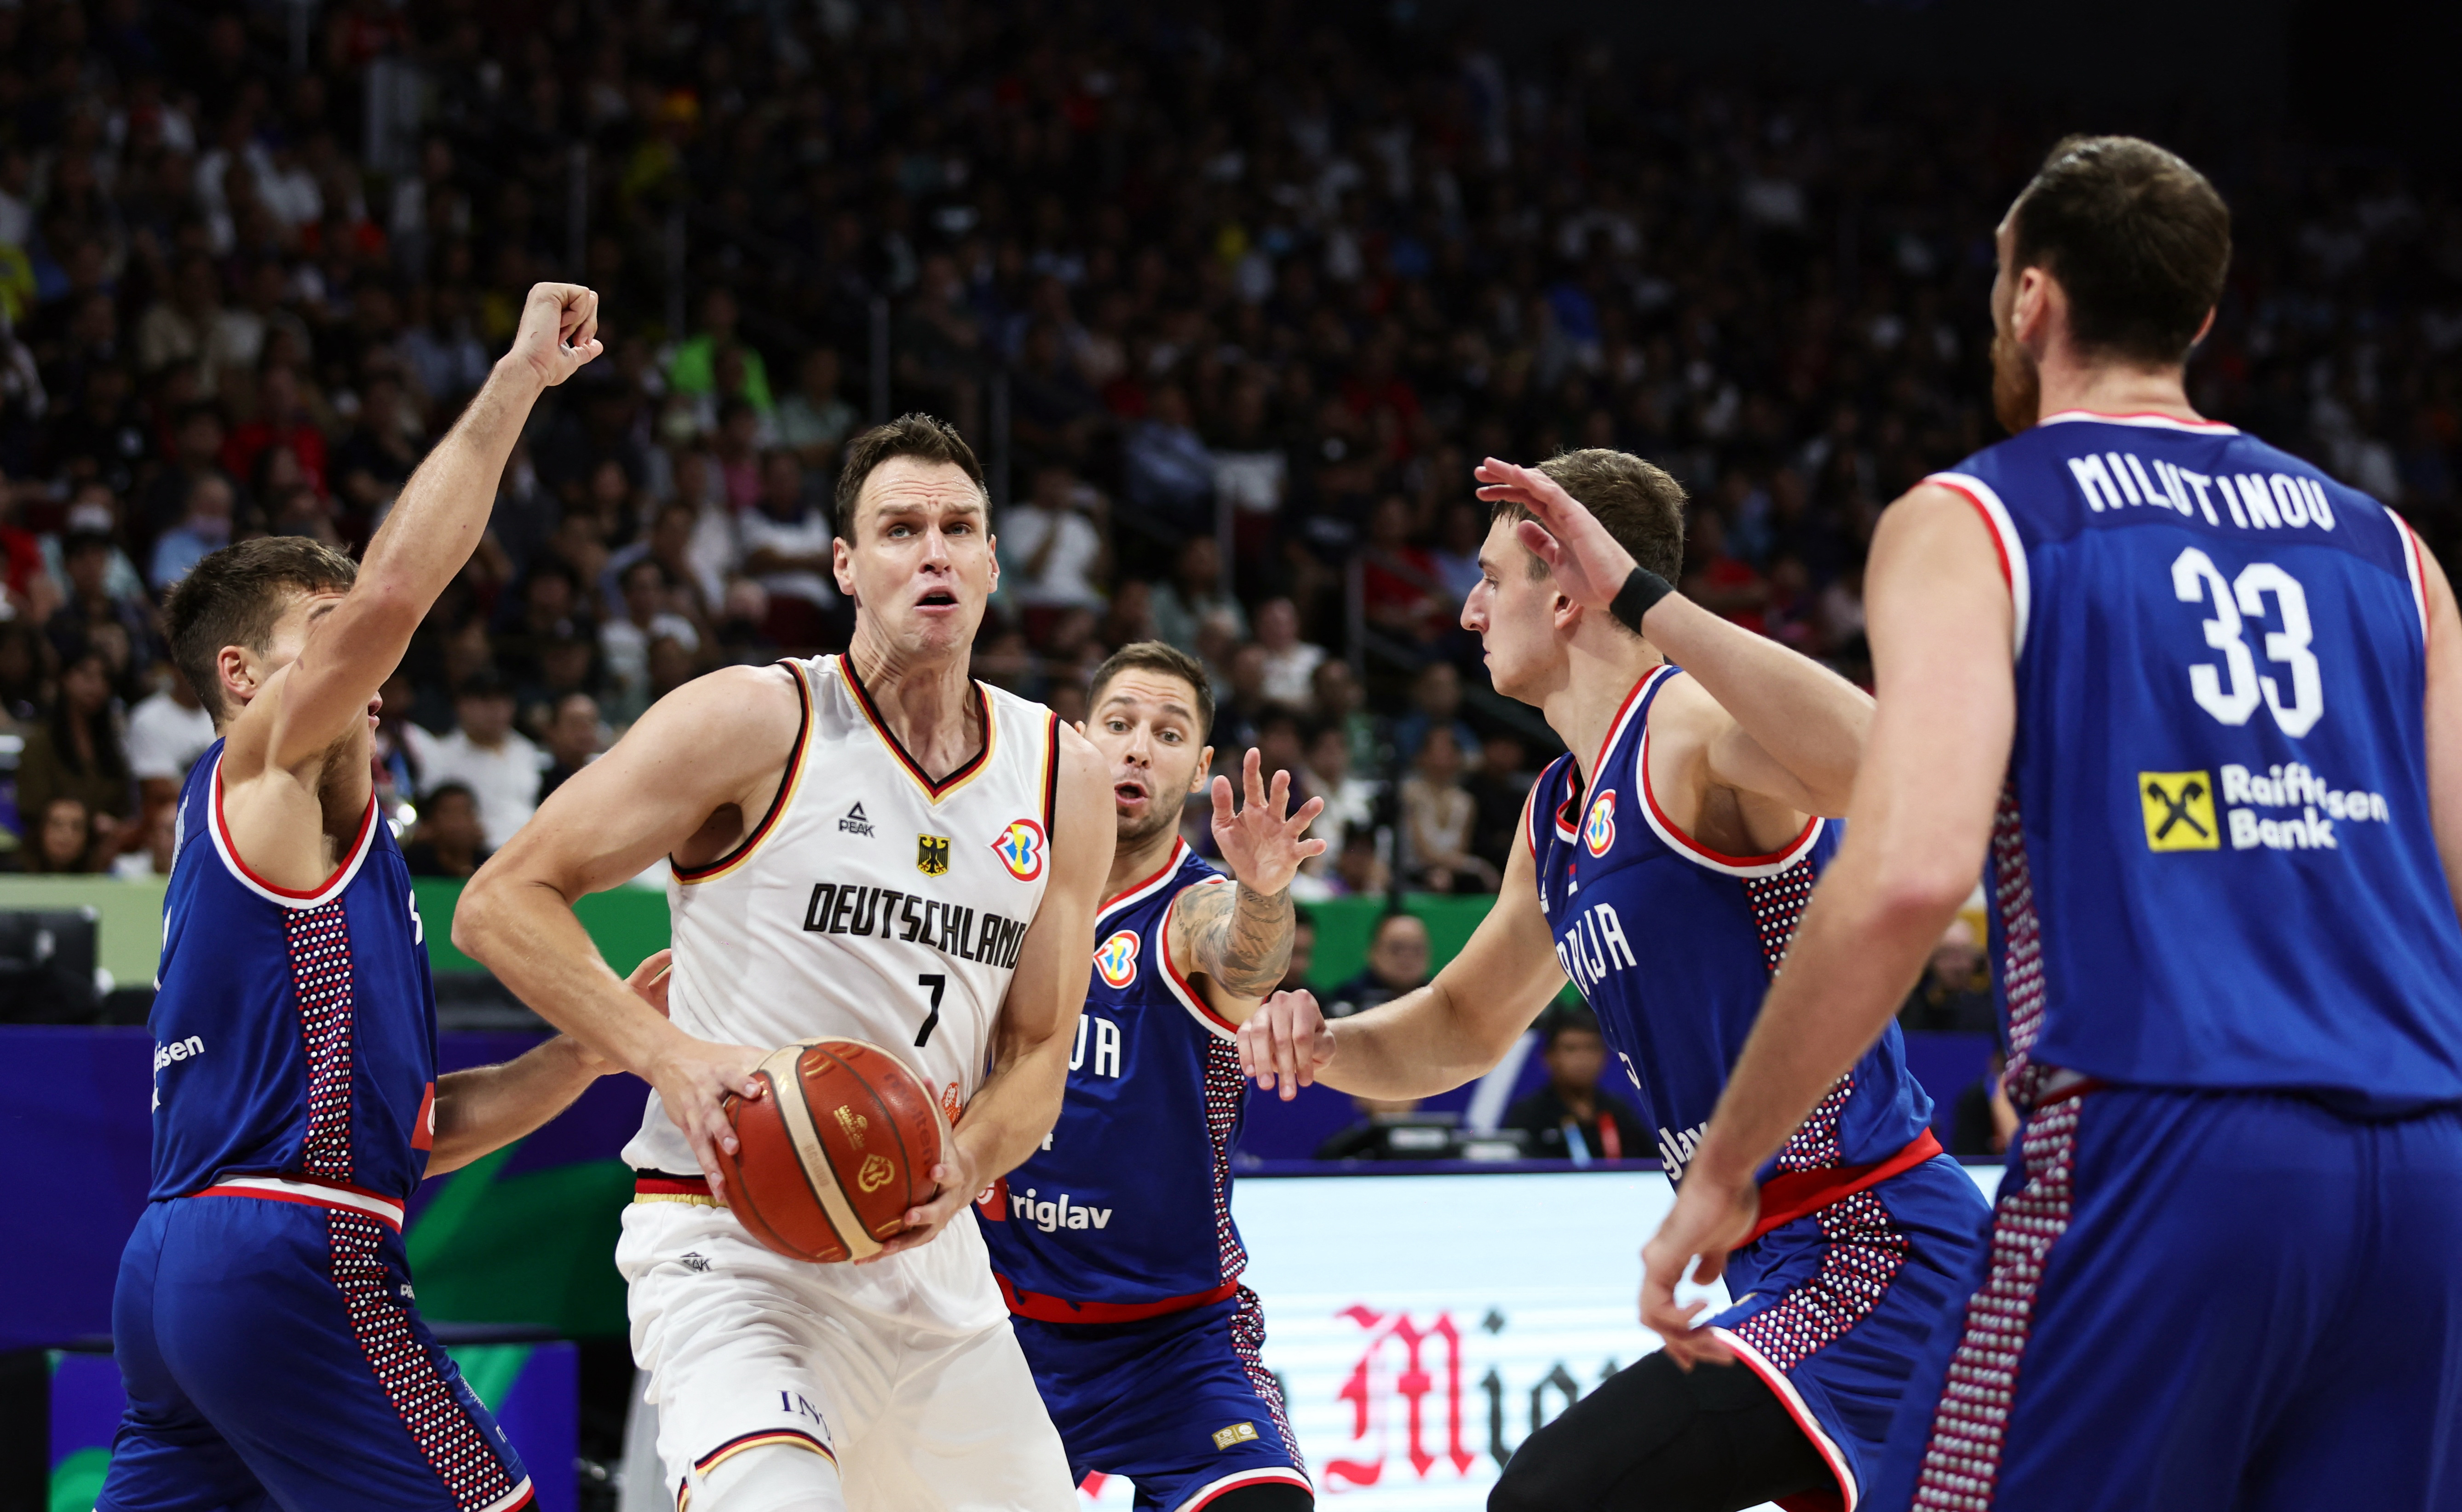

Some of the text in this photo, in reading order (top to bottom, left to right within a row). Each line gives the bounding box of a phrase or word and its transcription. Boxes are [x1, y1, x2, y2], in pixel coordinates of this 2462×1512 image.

[2171, 546, 2324, 738] 33
[839, 818, 875, 838] PEAK
[2227, 808, 2338, 851] Bank
[914, 974, 945, 1047] 7
[1007, 1184, 1113, 1232] riglav
